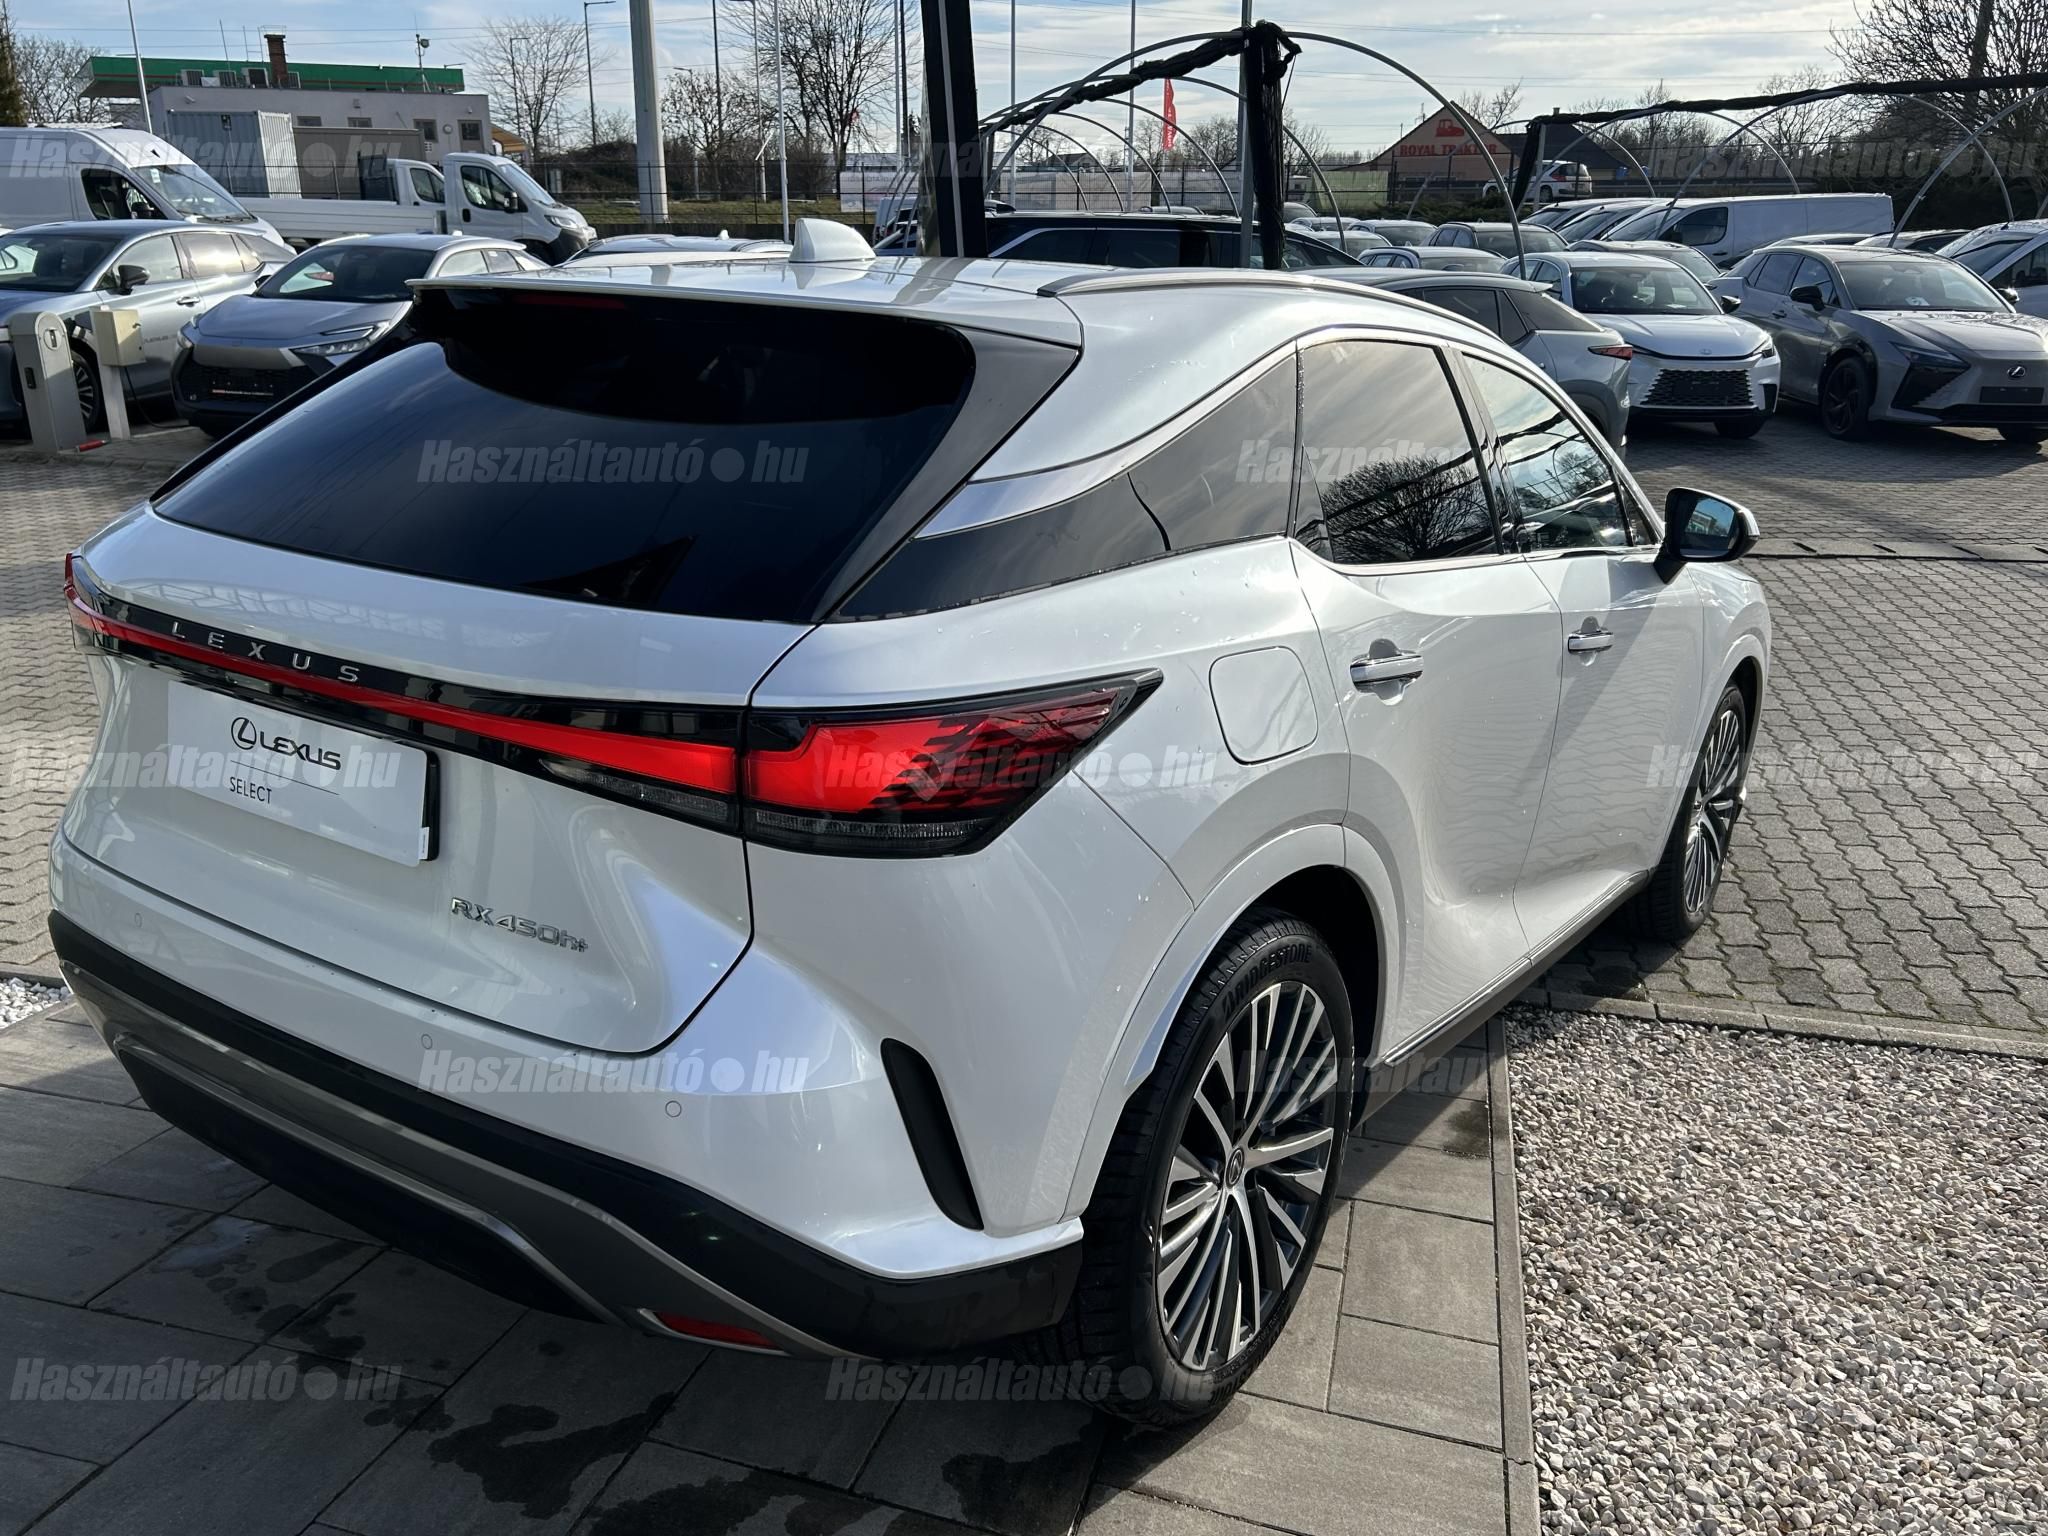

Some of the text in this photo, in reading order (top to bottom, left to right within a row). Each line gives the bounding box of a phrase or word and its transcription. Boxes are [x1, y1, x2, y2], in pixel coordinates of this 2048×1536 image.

[1399, 143, 1498, 156] ROYAL TRAKTR
[171, 620, 361, 683] LEXUS
[259, 730, 342, 771] LEXUS
[229, 775, 273, 805] SELECT
[1221, 943, 1313, 1019] BRIDGESTONE
